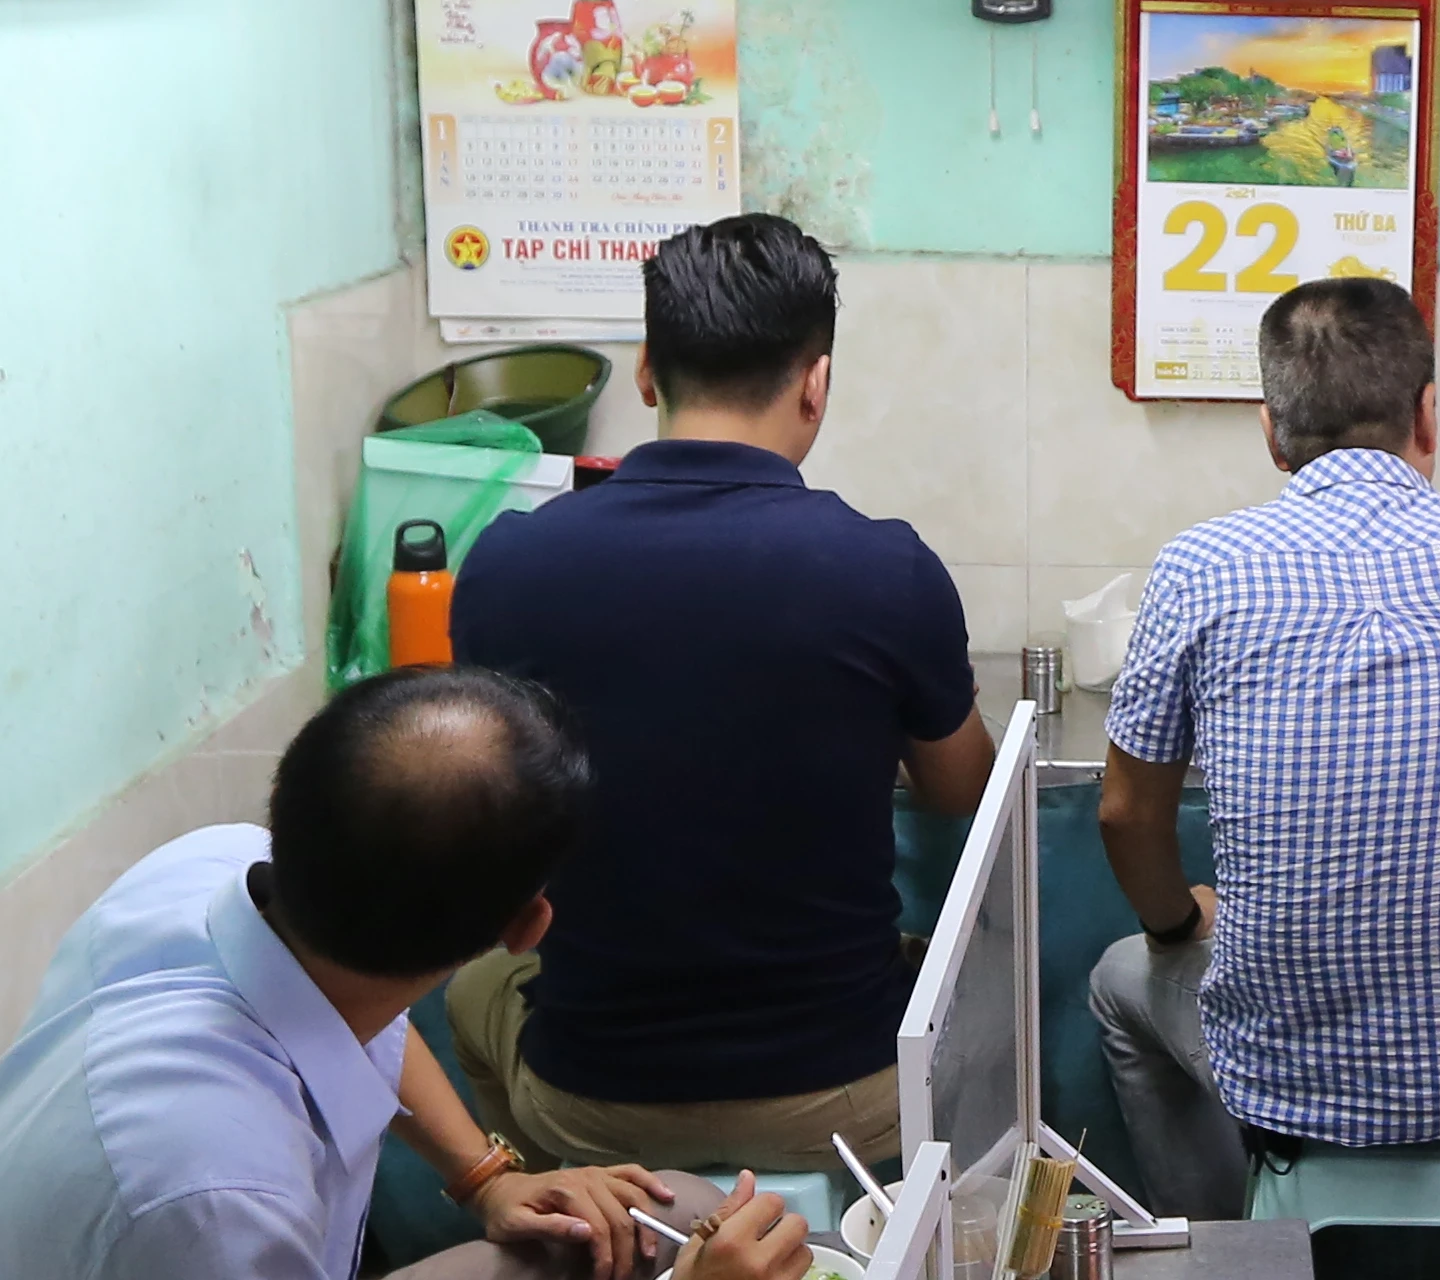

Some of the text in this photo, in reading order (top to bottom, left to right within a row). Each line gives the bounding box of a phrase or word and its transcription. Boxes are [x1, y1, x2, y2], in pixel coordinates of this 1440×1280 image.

[437, 120, 446, 140] 1
[713, 124, 726, 144] 2
[518, 221, 574, 233] THANH
[581, 221, 610, 234] TRA
[614, 218, 667, 234] CHÍNH
[1334, 209, 1396, 233] THỨ BA
[502, 238, 544, 265] TẠP
[553, 235, 590, 261] CHÍ
[1162, 200, 1300, 293] 22
[1173, 366, 1187, 377] 26
